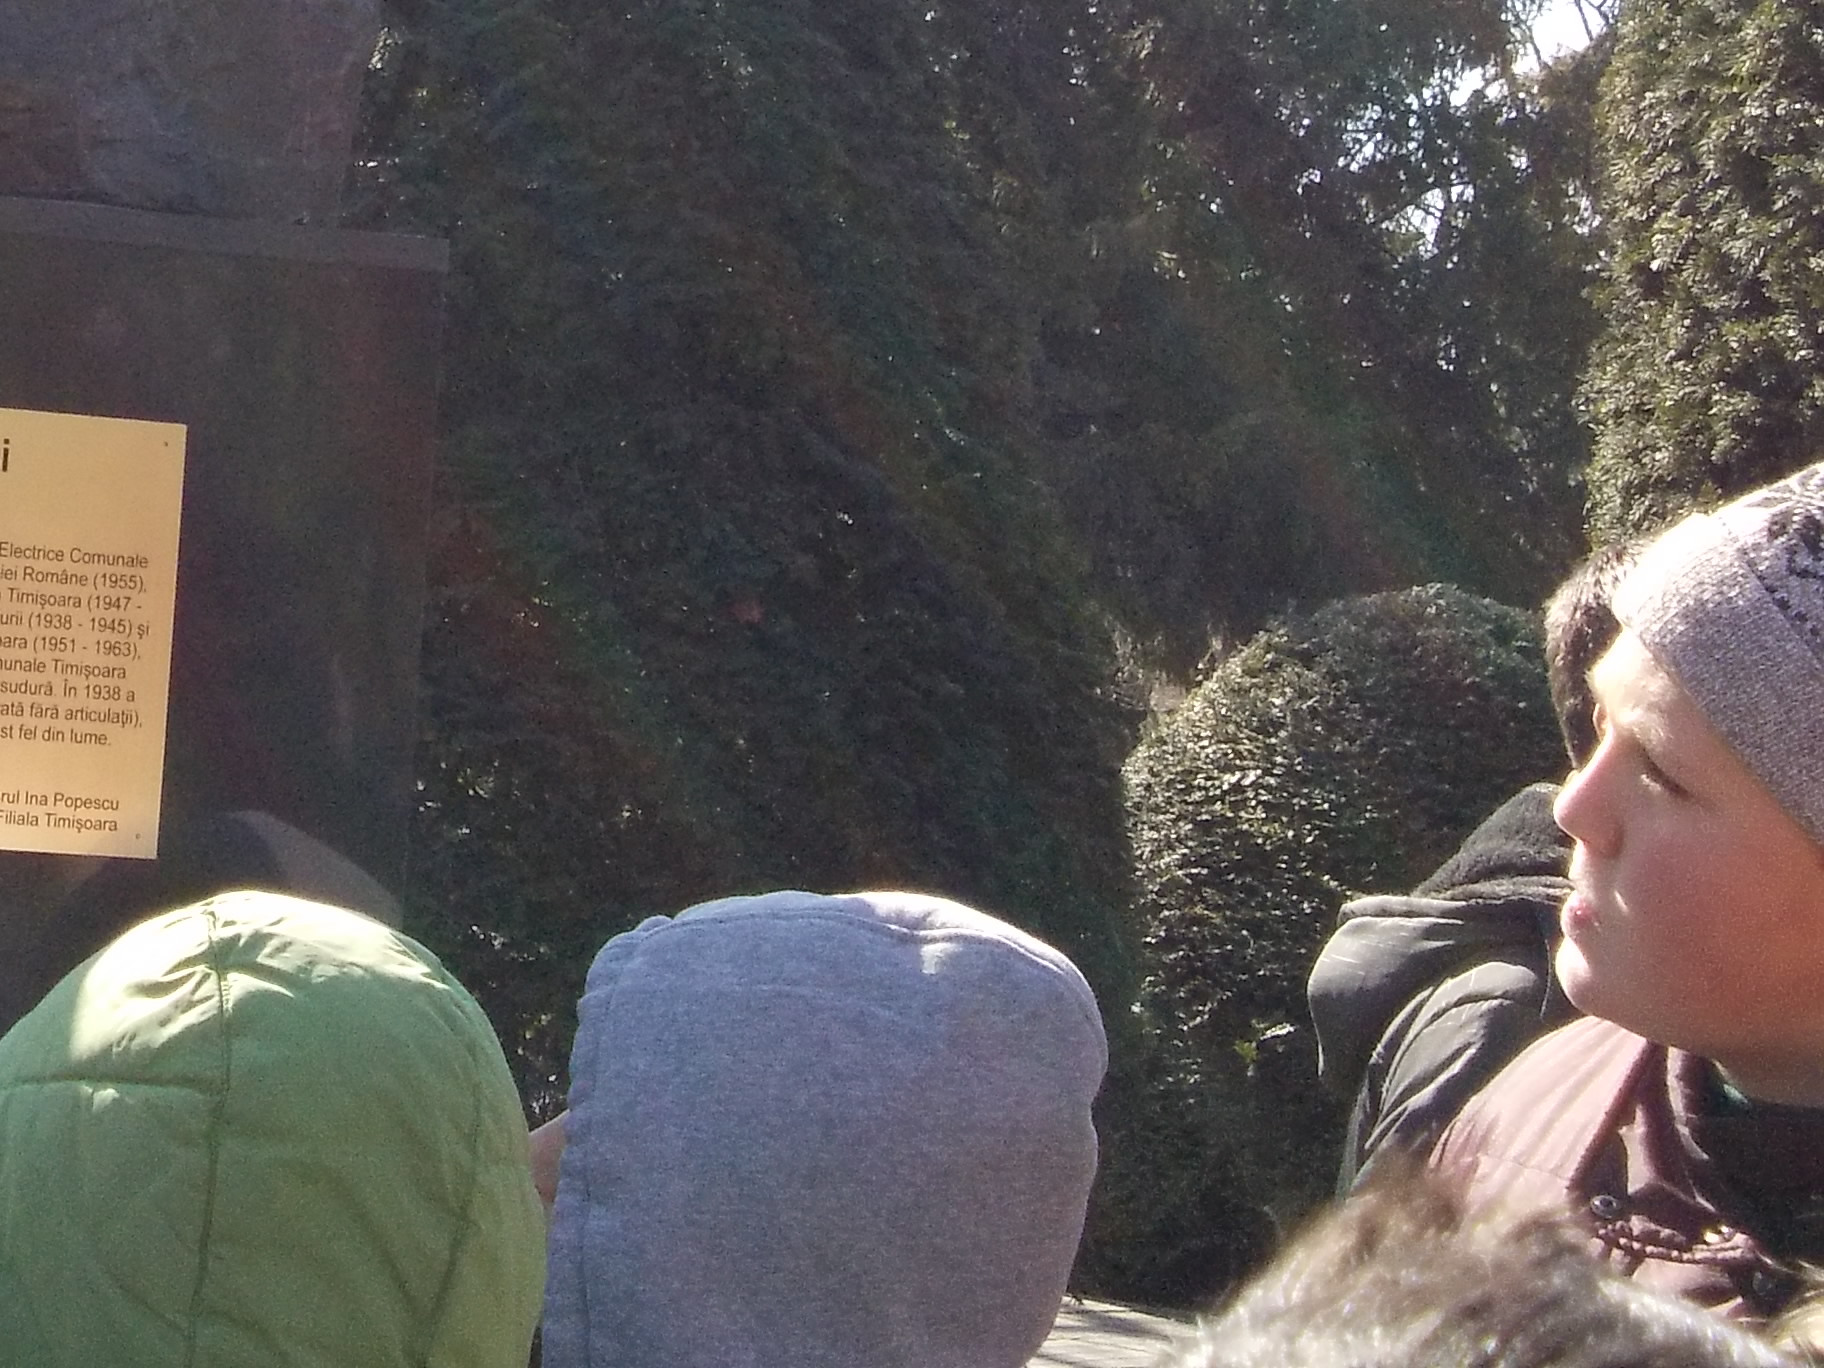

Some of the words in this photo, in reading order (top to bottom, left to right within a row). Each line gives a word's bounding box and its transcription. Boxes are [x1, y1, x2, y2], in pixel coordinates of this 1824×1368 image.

[69, 547, 149, 569] Comunale
[22, 565, 89, 587] Române
[87, 594, 132, 613] (1947
[28, 611, 73, 631] (1938
[90, 616, 133, 639] 1945)
[33, 635, 76, 654] (1951
[63, 675, 78, 698] În
[85, 683, 121, 702] 1938
[125, 690, 136, 703] a
[18, 723, 38, 741] fel
[41, 725, 65, 743] din
[24, 790, 49, 807] Ina
[53, 791, 120, 812] Popescu
